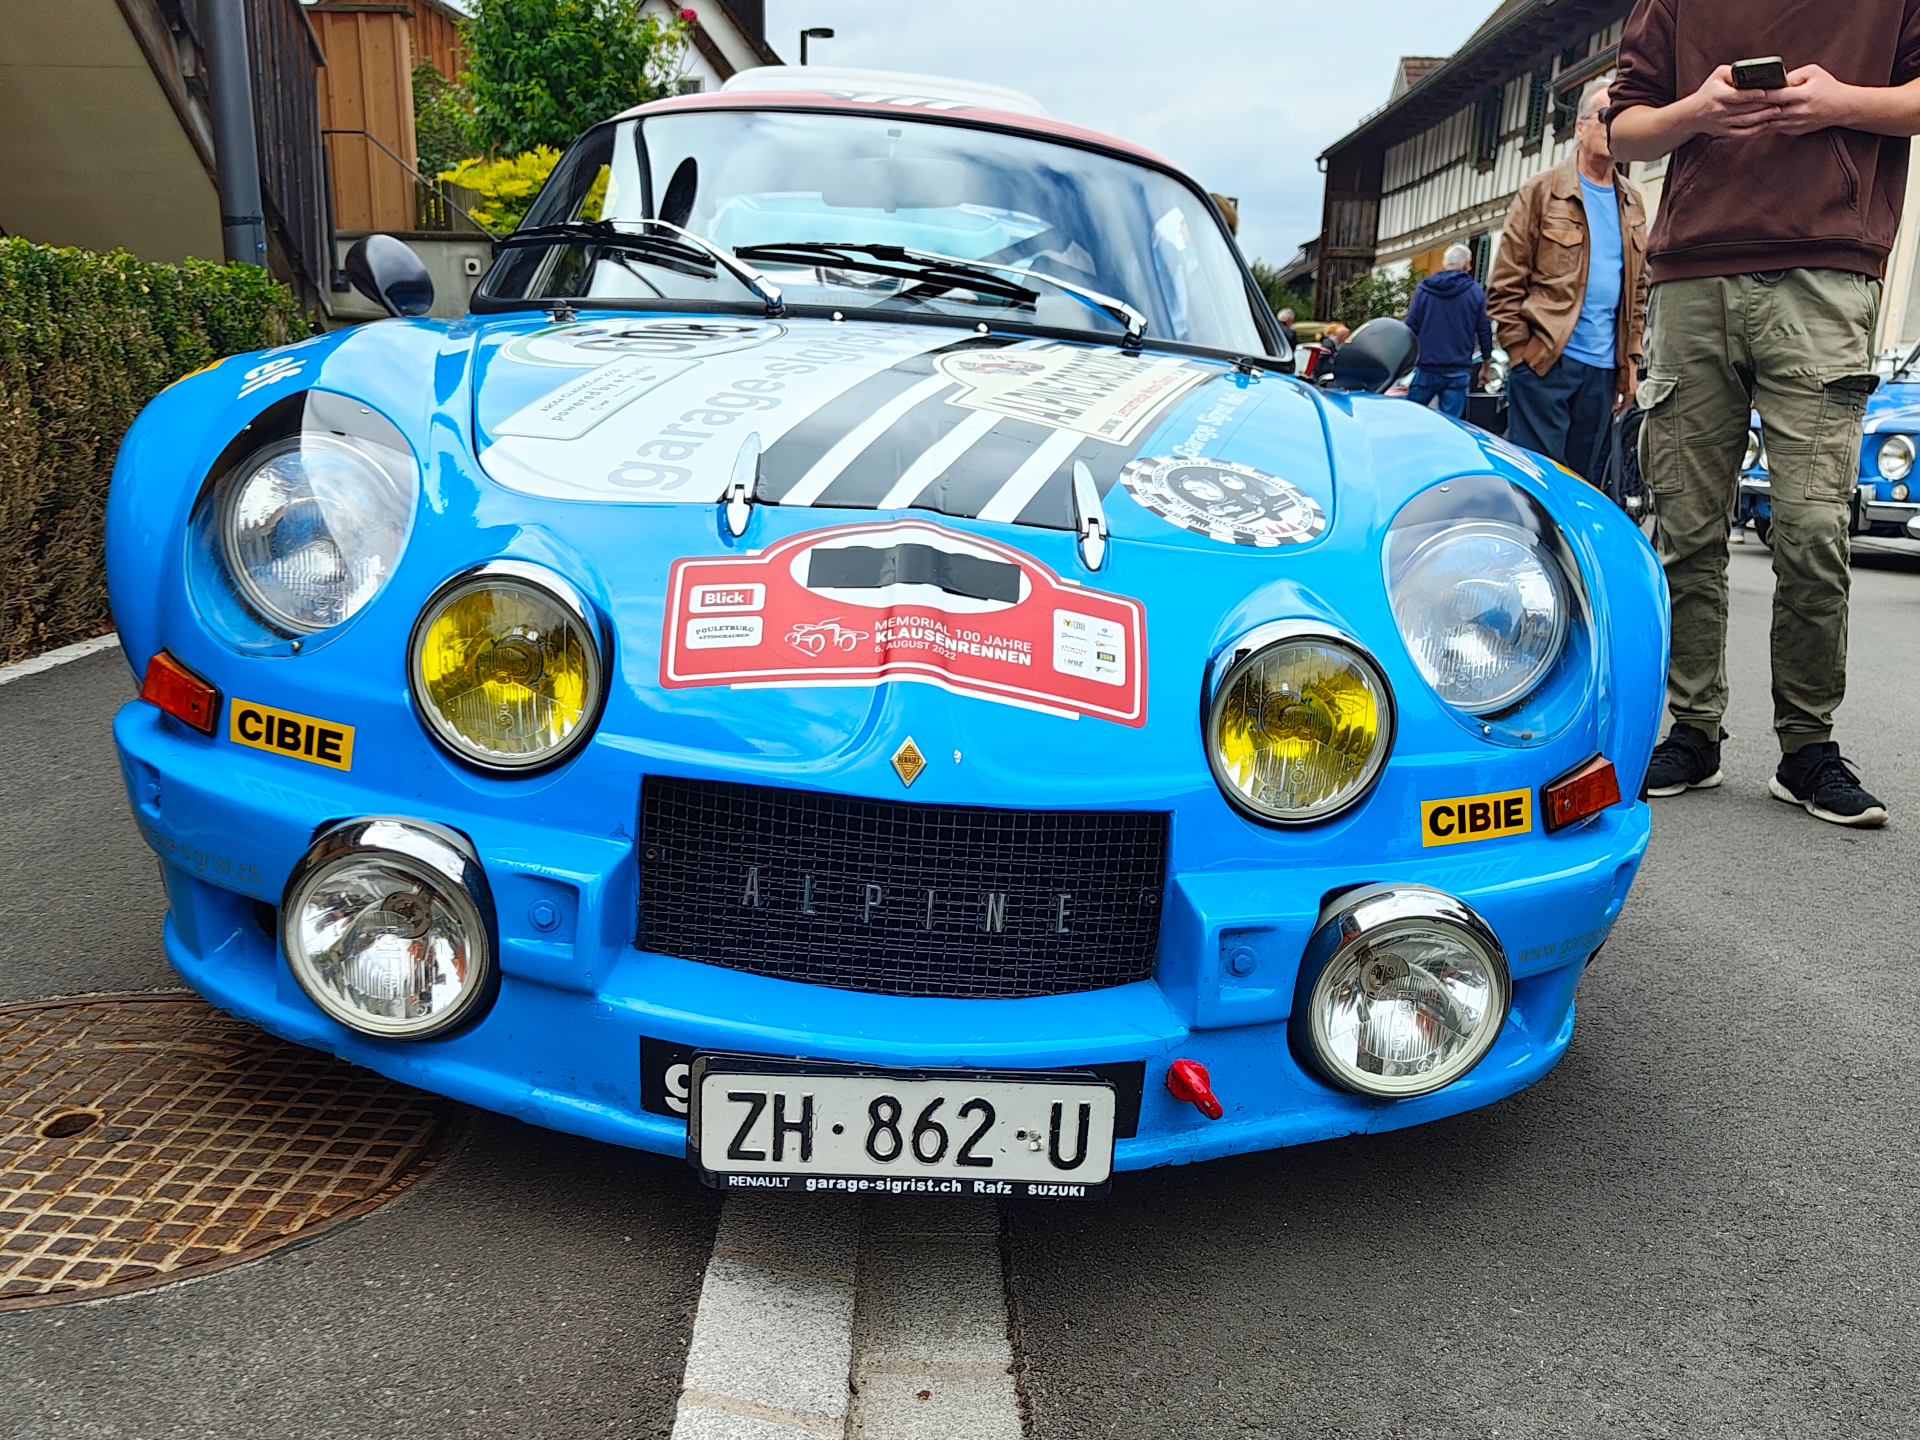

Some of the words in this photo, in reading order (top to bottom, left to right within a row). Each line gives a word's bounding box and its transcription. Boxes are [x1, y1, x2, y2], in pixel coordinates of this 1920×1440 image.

[550, 388, 602, 422] powered
[983, 381, 1108, 425] ALPINE
[1172, 424, 1220, 457] Garage
[704, 591, 745, 605] Blick
[695, 625, 755, 635] POULETBURG
[875, 616, 951, 637] MEMORIAL
[955, 628, 981, 643] 100
[984, 635, 1032, 653] JAHRE
[875, 627, 1032, 667] KLAUSENRENNEN
[875, 644, 884, 653] 6.
[886, 639, 931, 651] AUGUST
[932, 644, 957, 661] 2022
[238, 709, 344, 764] CIBIE
[1429, 797, 1524, 837] CIBIE
[742, 867, 1072, 933] ALPINE
[727, 1091, 813, 1162] ZH
[865, 1094, 997, 1168] 862
[1048, 1101, 1092, 1171] U
[729, 1176, 790, 1188] RENAULT
[806, 1177, 961, 1193] garage-sigrist.ch
[974, 1181, 1012, 1194] Rafz
[1028, 1184, 1086, 1197] SUZUKI
